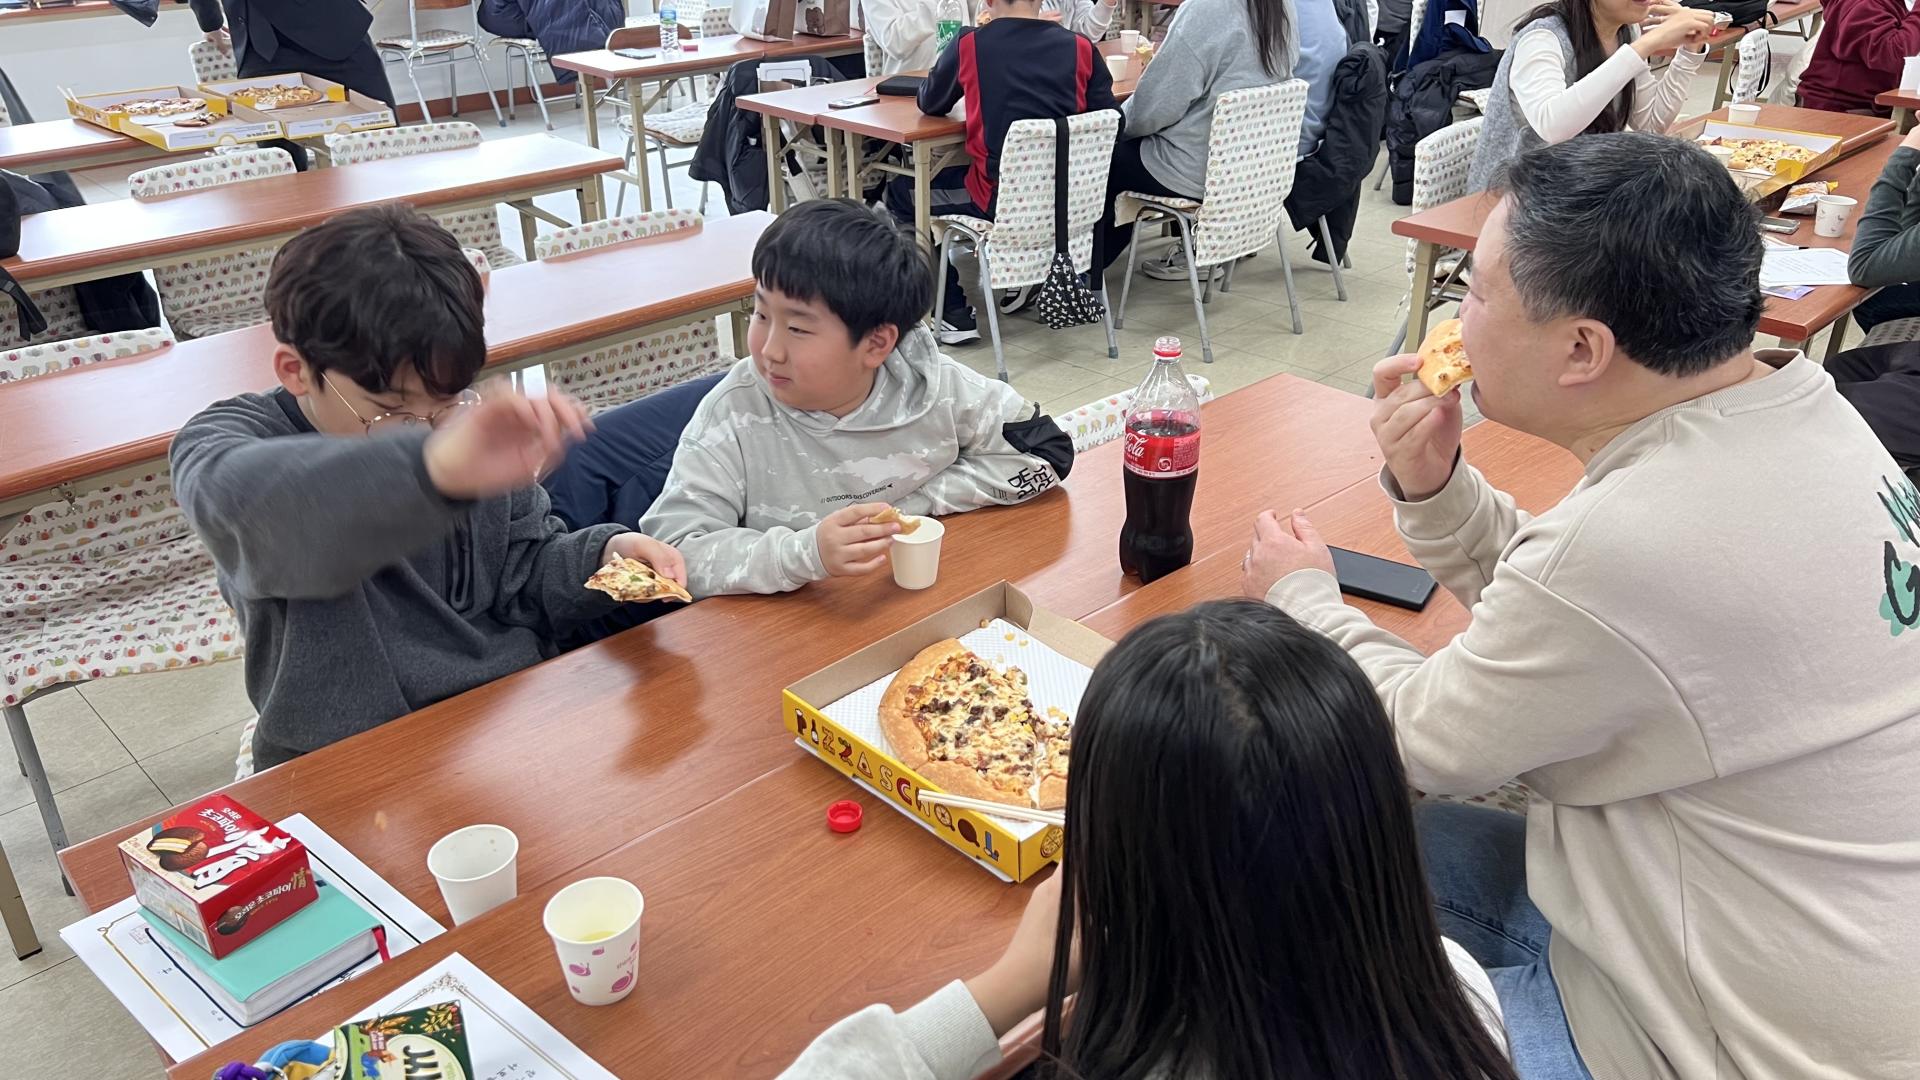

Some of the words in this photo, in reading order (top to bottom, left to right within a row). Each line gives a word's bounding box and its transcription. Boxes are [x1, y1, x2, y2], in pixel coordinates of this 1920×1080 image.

[198, 807, 240, 835] 초코파이
[221, 807, 242, 820] 오리온
[234, 900, 257, 921] 오리온
[256, 882, 292, 905] 초코파이
